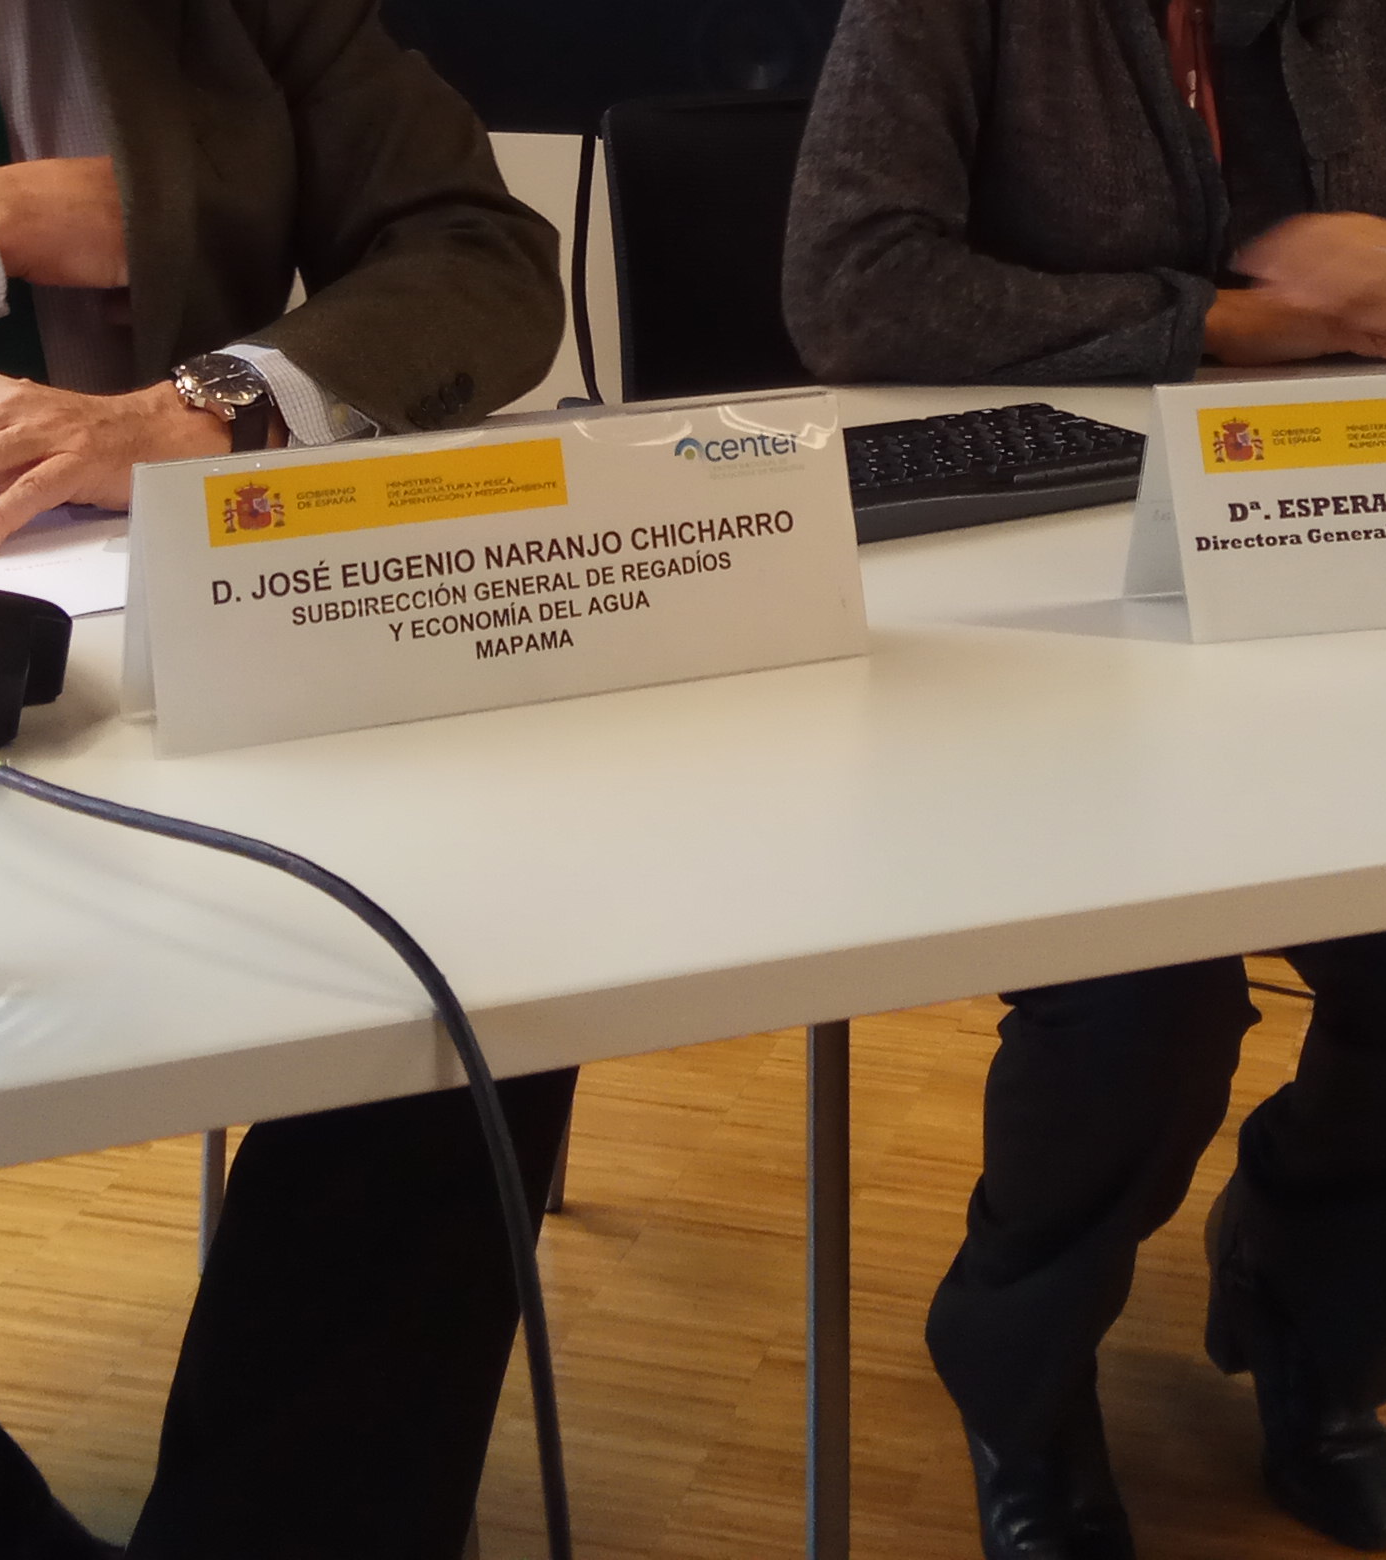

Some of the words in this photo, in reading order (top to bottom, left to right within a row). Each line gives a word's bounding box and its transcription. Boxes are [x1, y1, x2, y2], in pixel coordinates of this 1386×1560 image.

[212, 580, 242, 605] D.
[251, 560, 332, 600] JOSÉ
[341, 548, 476, 588] EUGENIO
[484, 531, 622, 570] NARANJO
[630, 509, 795, 551] CHICHARRO
[1195, 530, 1303, 552] Directora
[291, 583, 468, 627] SUBDIRECCIÓN
[473, 571, 581, 602] GENERAL
[586, 566, 616, 588] DE
[621, 550, 732, 583] REGADÍOS
[388, 622, 404, 642] Y
[412, 602, 532, 639] ECONOMÍA
[538, 600, 582, 622] DEL
[588, 590, 651, 616] AGUA
[475, 628, 574, 660] MAPAMA
